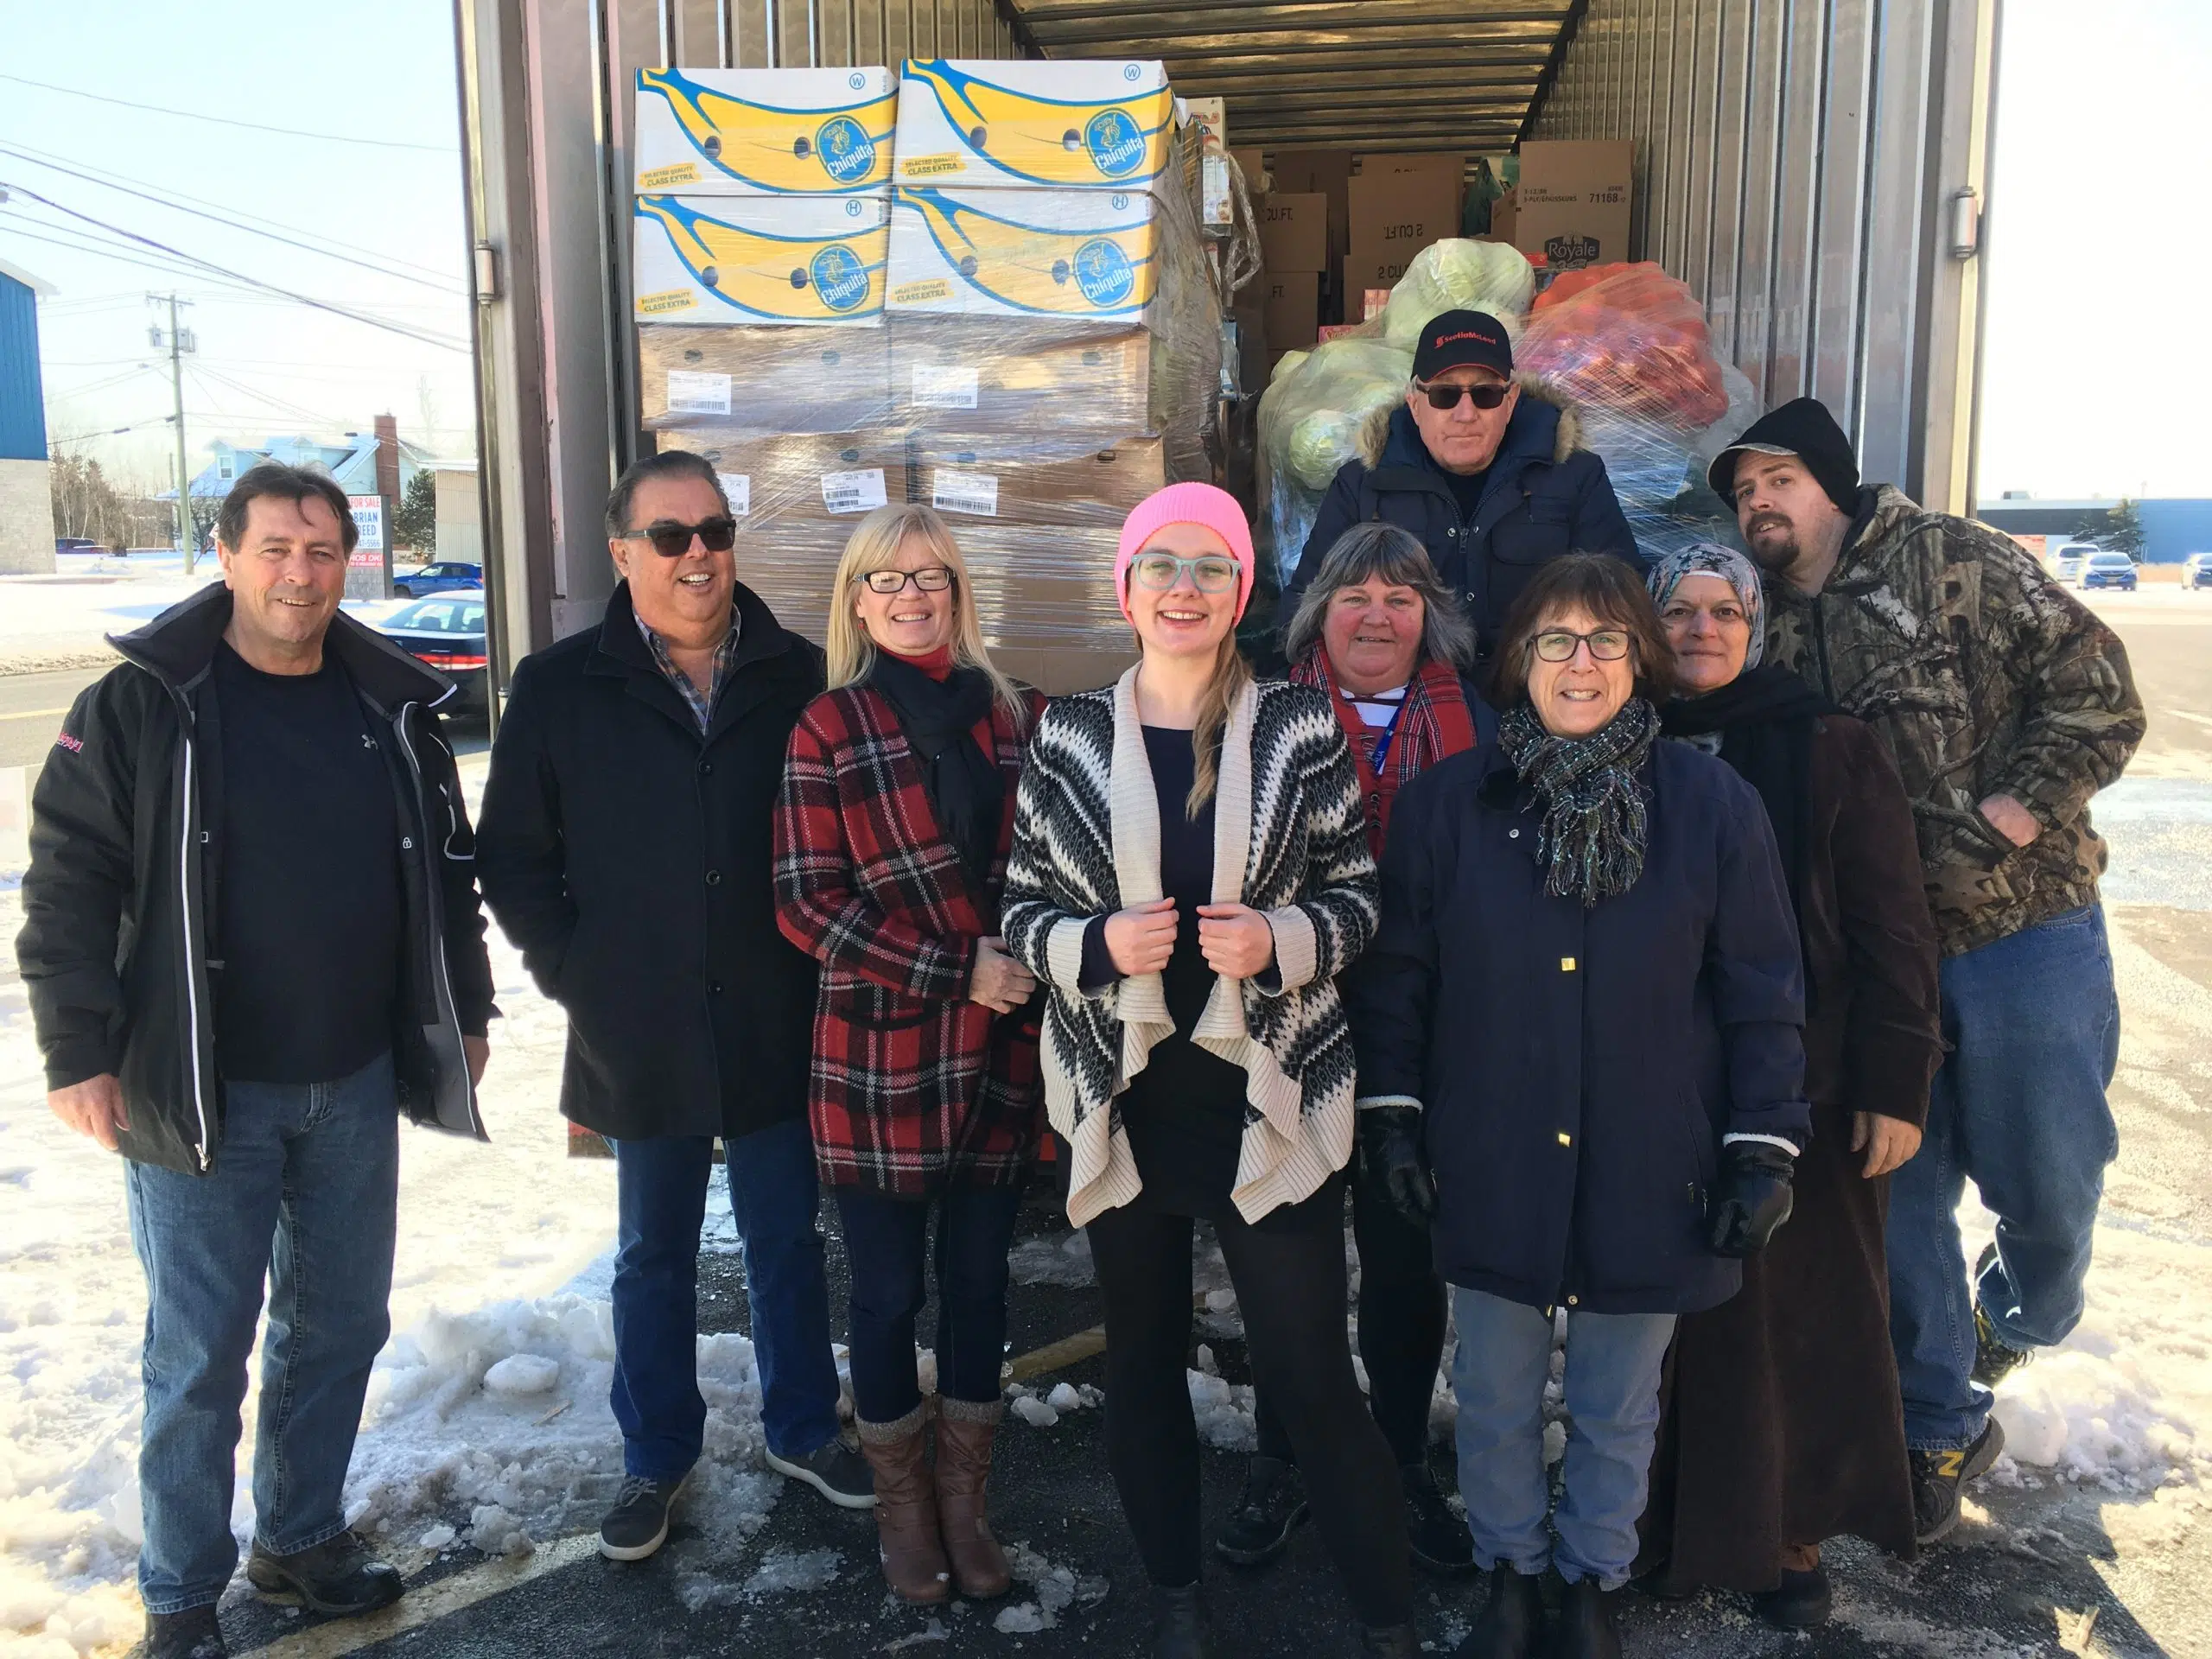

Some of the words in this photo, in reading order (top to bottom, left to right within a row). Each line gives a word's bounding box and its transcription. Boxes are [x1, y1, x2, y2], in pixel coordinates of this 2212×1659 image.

[826, 143, 874, 177] Chiquita
[1095, 137, 1144, 170] Chiquita
[907, 166, 931, 175] CLASS
[932, 162, 958, 173] EXTRA
[646, 177, 669, 187] CLASS
[670, 173, 695, 183] EXTRA
[1589, 193, 1618, 204] 71168
[1548, 241, 1597, 261] Royale
[1377, 265, 1385, 280] 2
[820, 271, 868, 305] Chiquita
[1084, 267, 1133, 300] Chiquita
[897, 292, 920, 302] CLASS
[920, 289, 946, 299] EXTRA
[644, 302, 667, 312] CLASS
[667, 298, 690, 308] EXTRA
[350, 497, 364, 508] FOR
[365, 497, 380, 508] SALE
[353, 511, 378, 524] BRIAN
